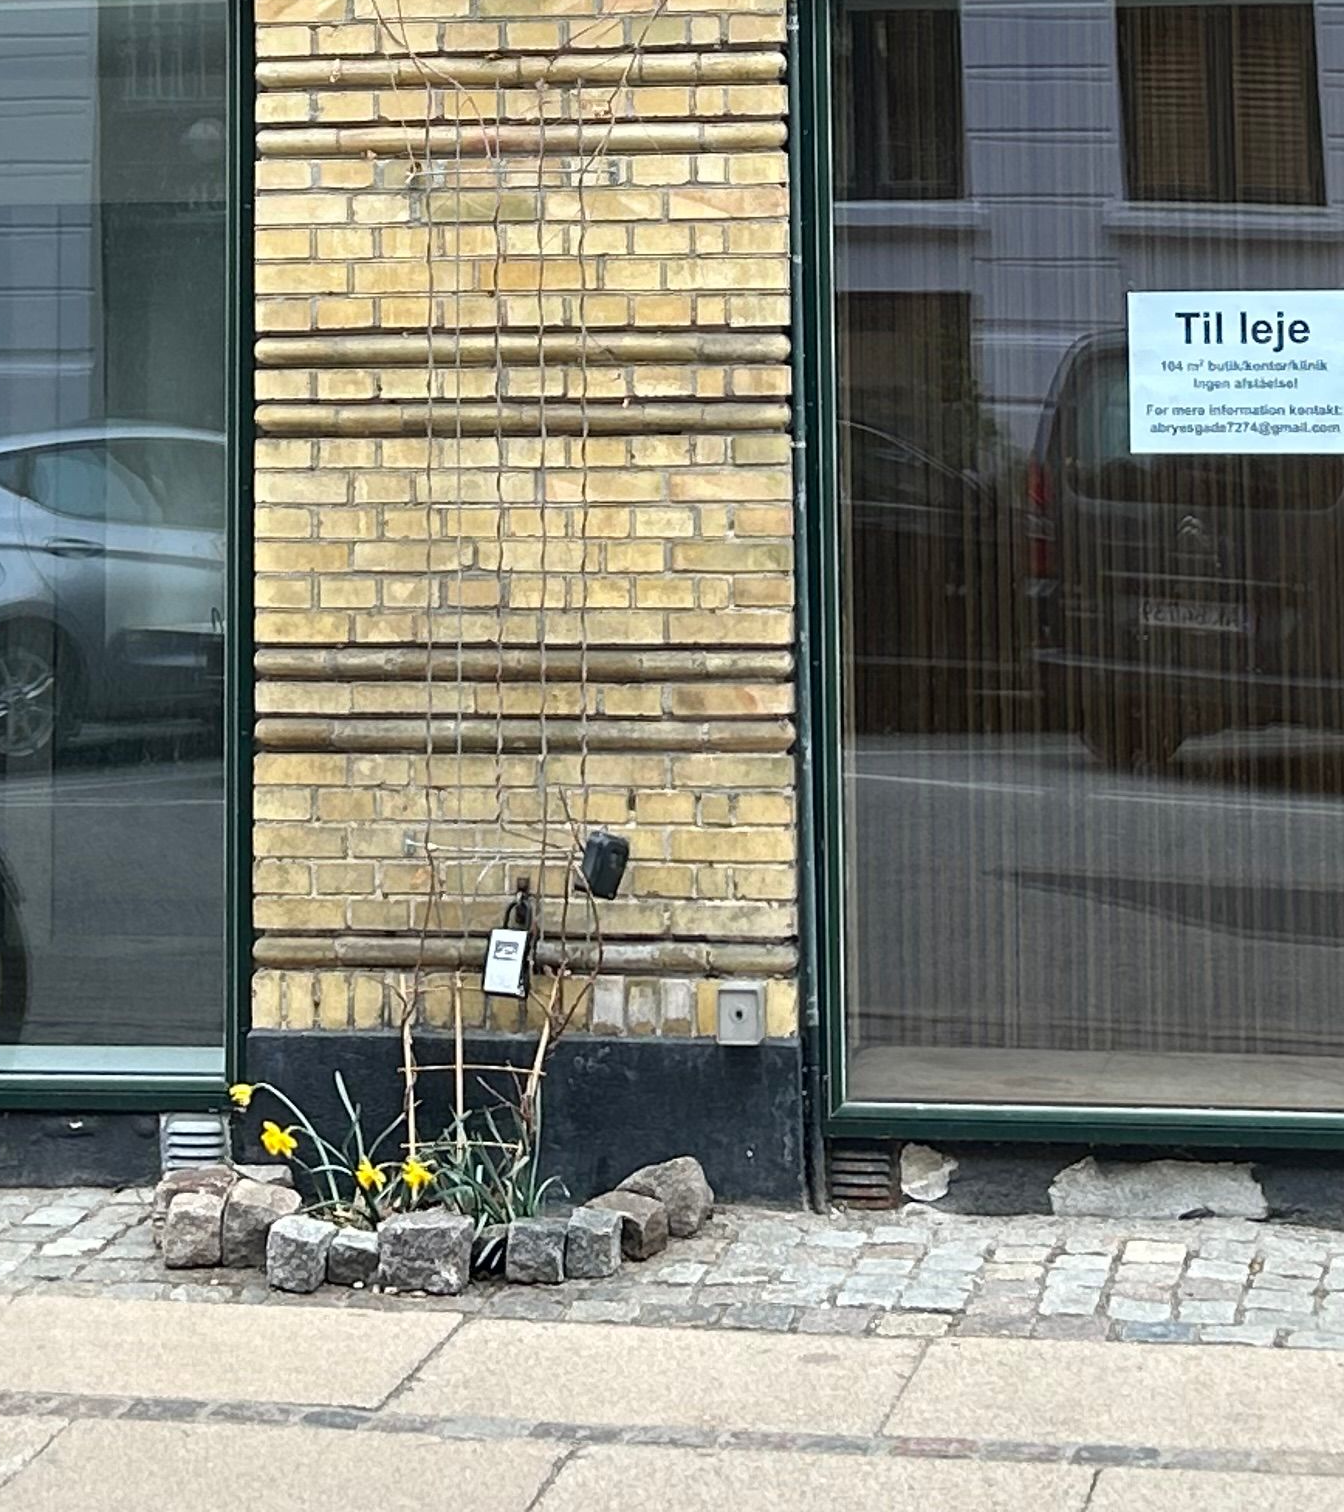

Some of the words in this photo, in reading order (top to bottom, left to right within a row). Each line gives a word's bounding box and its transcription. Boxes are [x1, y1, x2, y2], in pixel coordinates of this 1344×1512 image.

[1175, 311, 1223, 345] Til
[1239, 311, 1311, 353] leje
[1160, 360, 1184, 373] 104
[1193, 377, 1231, 392] Ingen
[1146, 403, 1169, 416] For
[1171, 406, 1206, 416] mere
[1208, 403, 1286, 416] information
